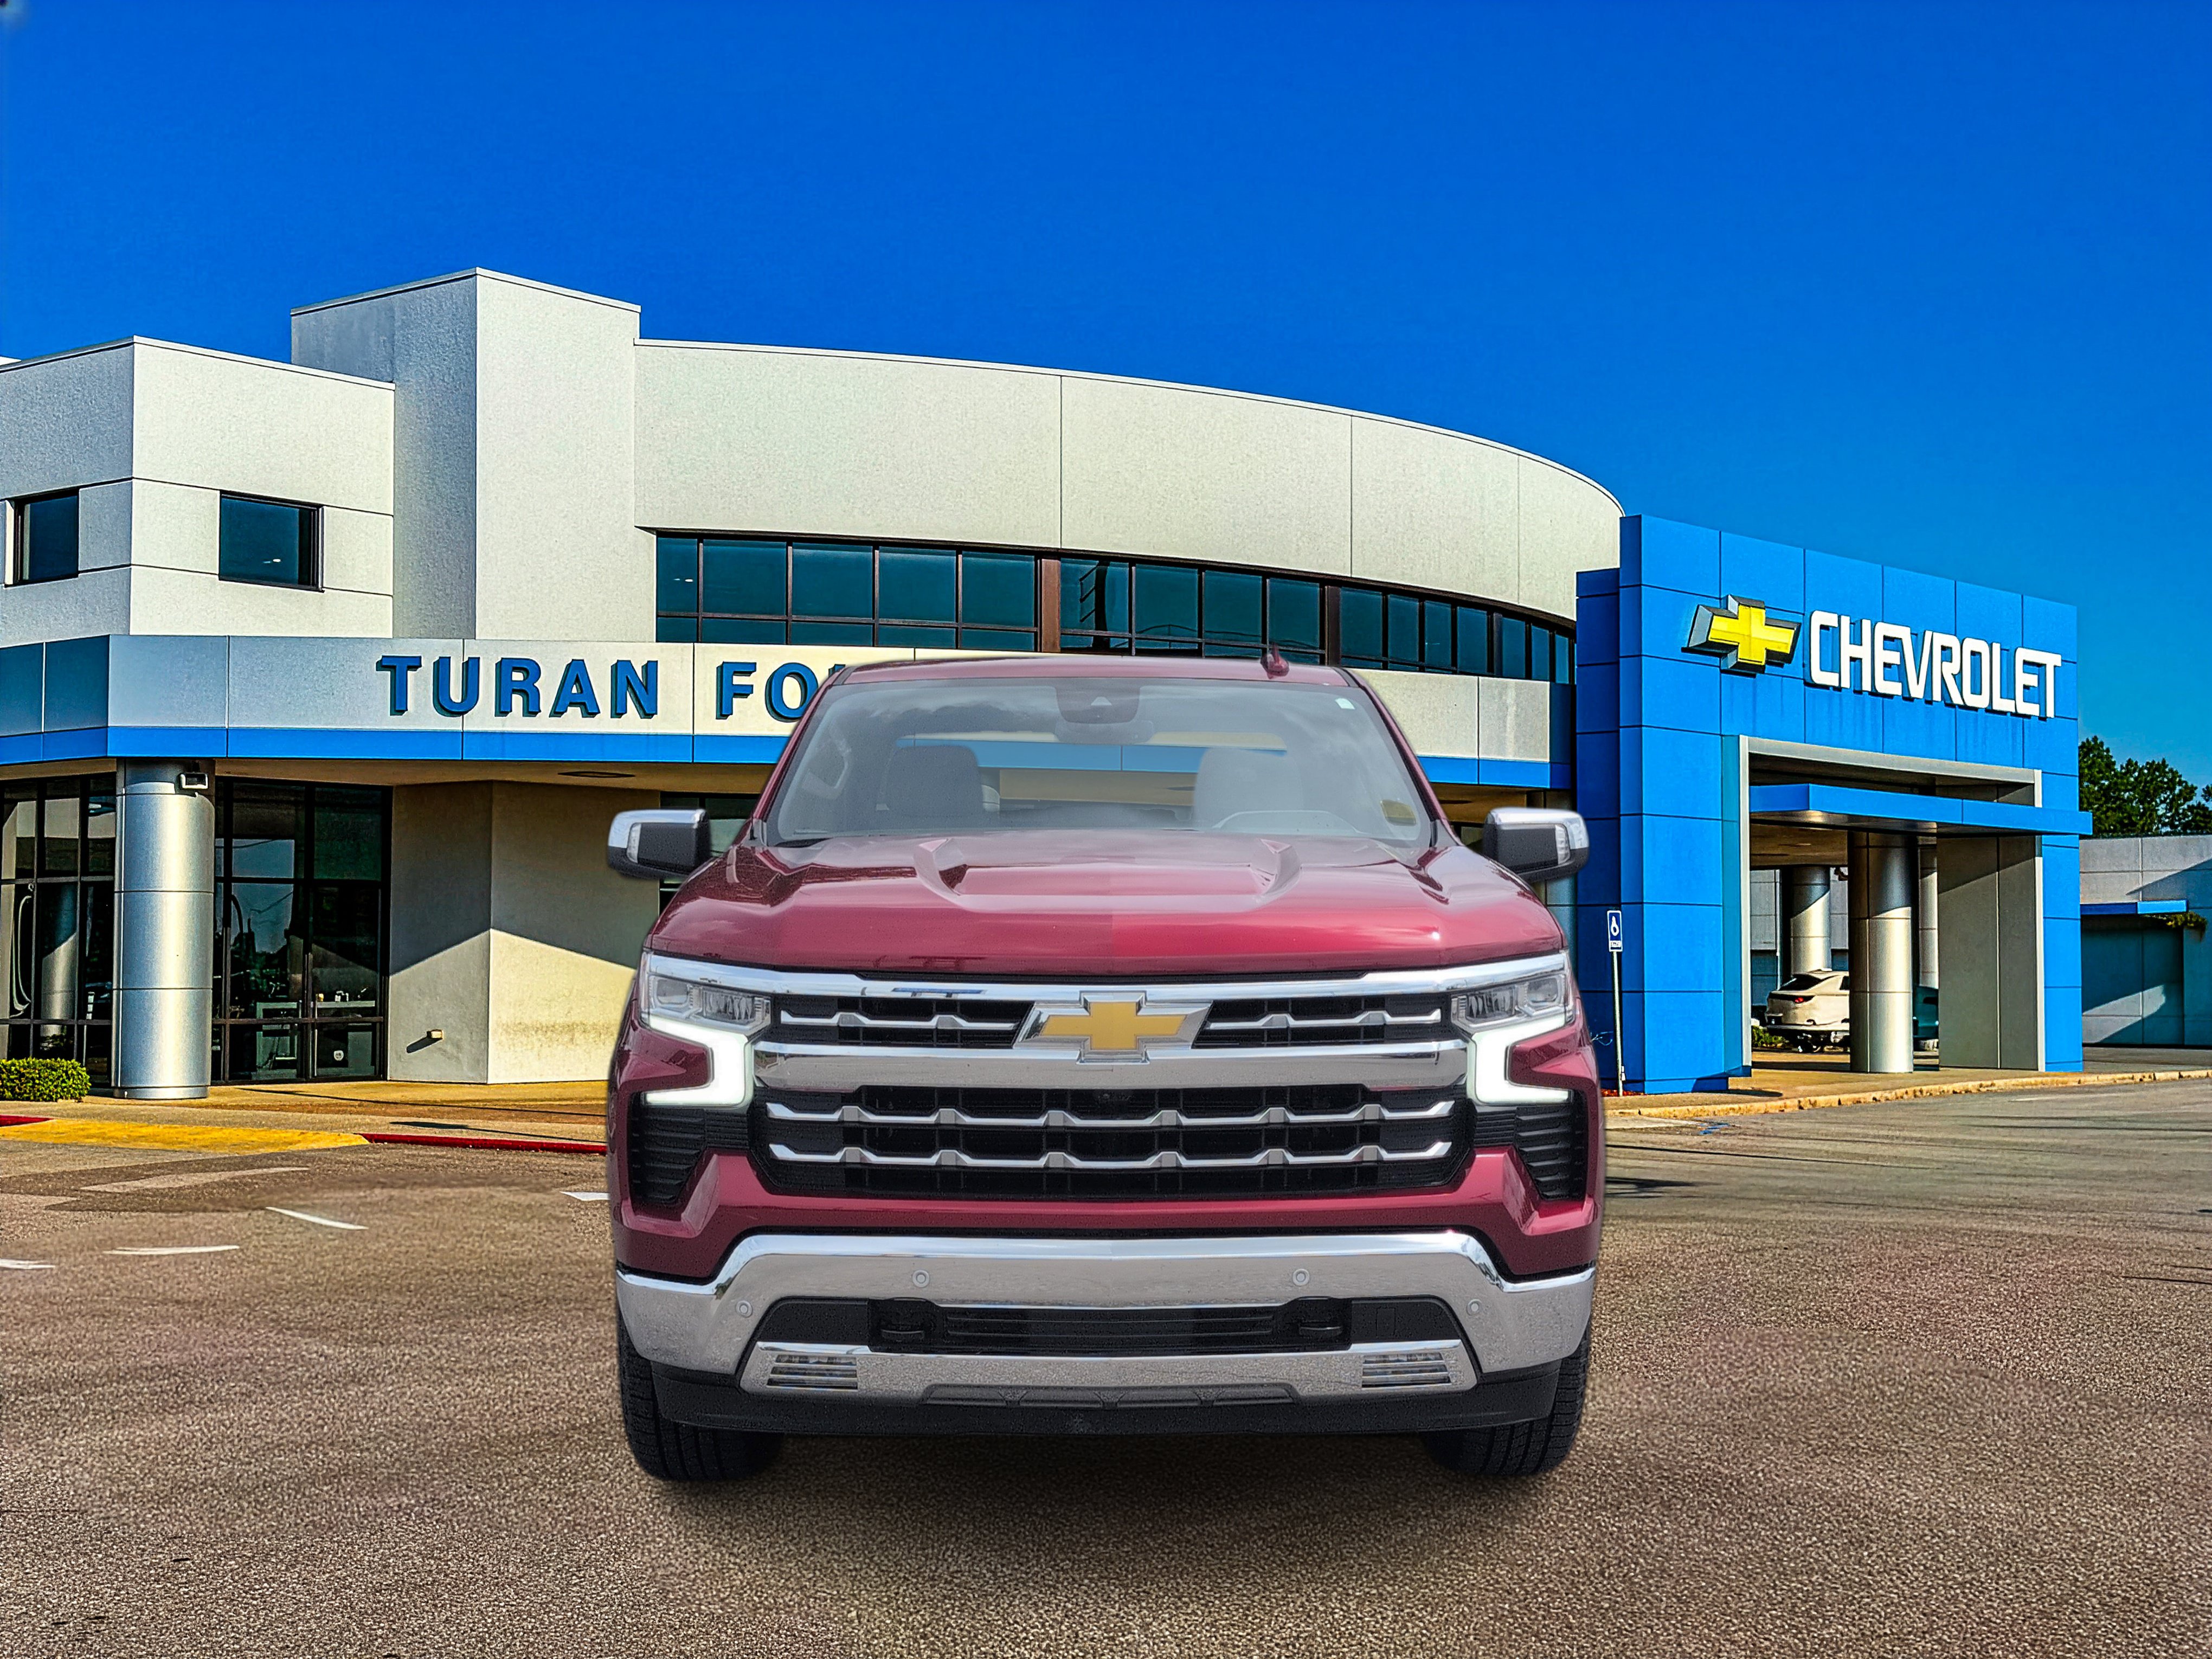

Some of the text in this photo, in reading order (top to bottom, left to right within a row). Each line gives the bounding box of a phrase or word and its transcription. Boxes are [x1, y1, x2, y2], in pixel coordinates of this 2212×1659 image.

[376, 655, 846, 722] TURAN FO
[1810, 610, 2062, 719] CHEVROLET
